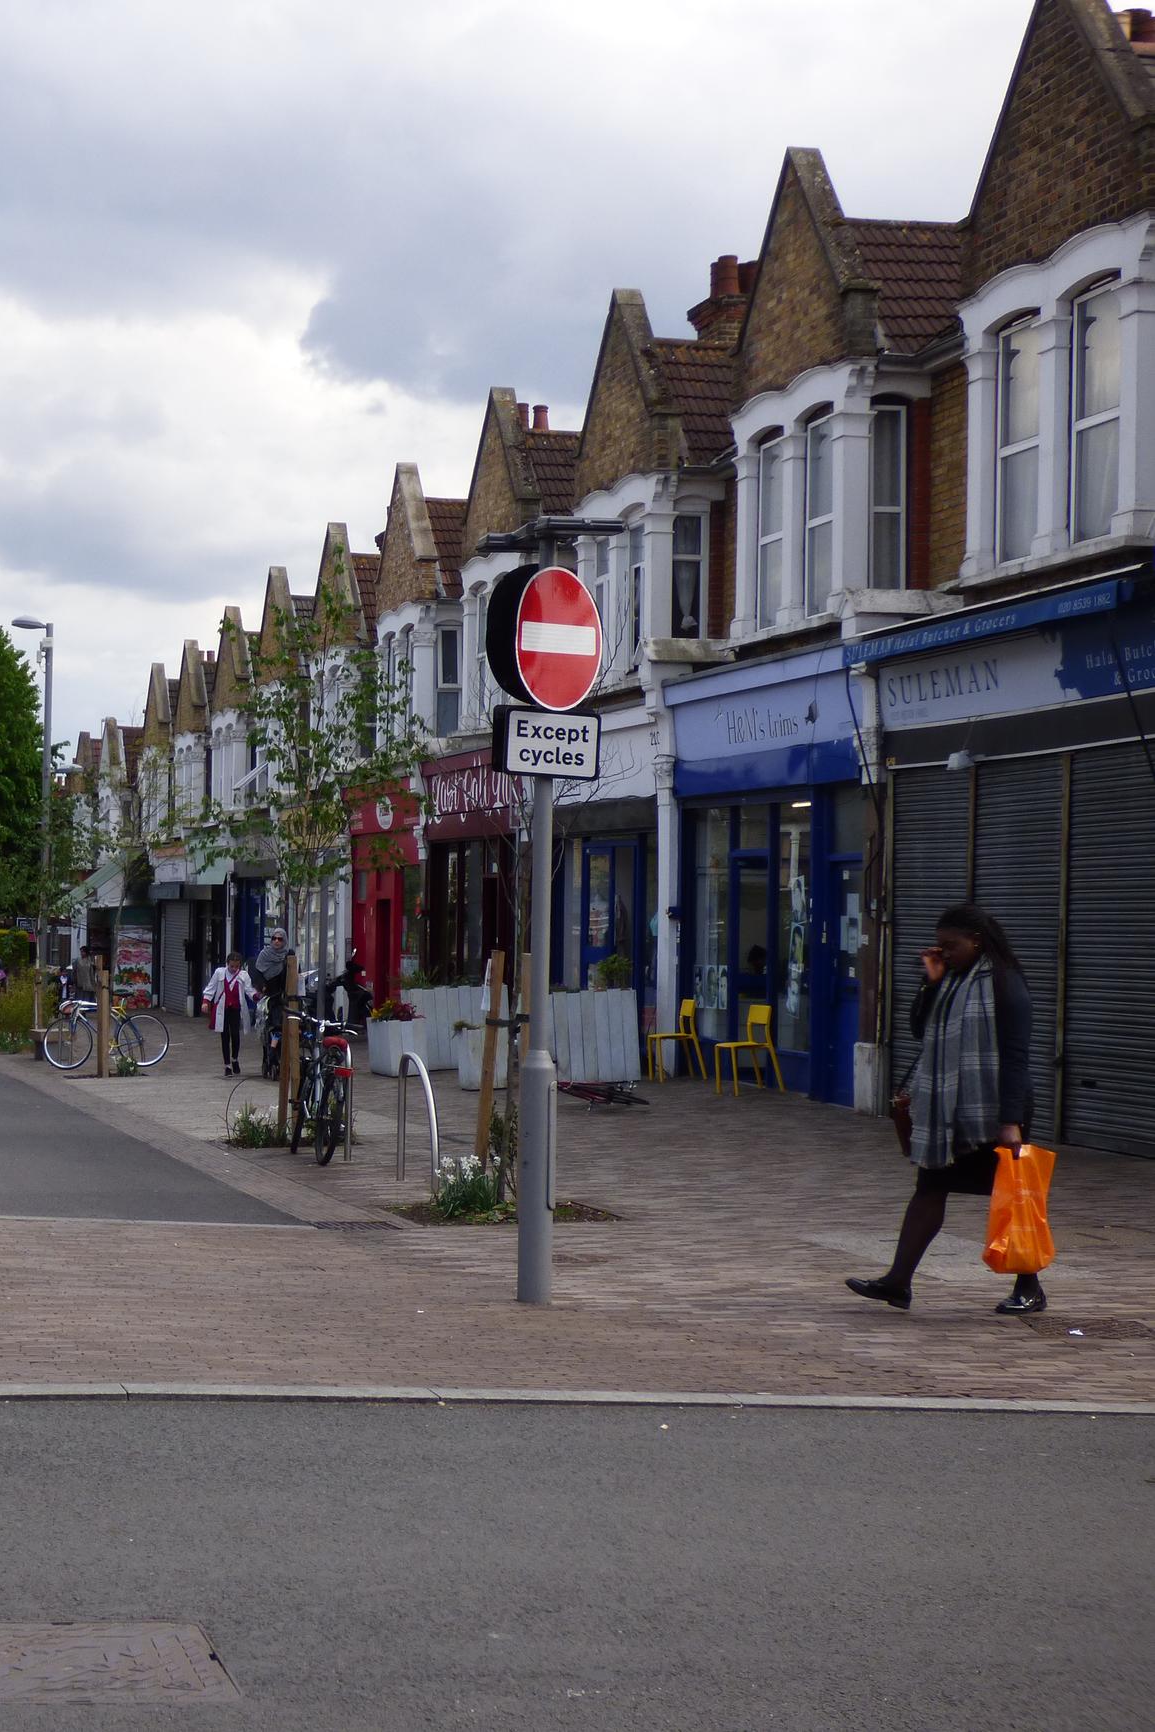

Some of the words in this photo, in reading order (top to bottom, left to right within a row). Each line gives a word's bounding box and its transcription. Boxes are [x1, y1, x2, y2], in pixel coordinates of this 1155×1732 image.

[845, 637, 894, 662] SULEMAN
[974, 613, 1017, 632] Grocers
[887, 659, 999, 707] SULEMAN
[516, 719, 590, 745] Except
[767, 708, 799, 738] trims
[519, 746, 585, 767] cycles
